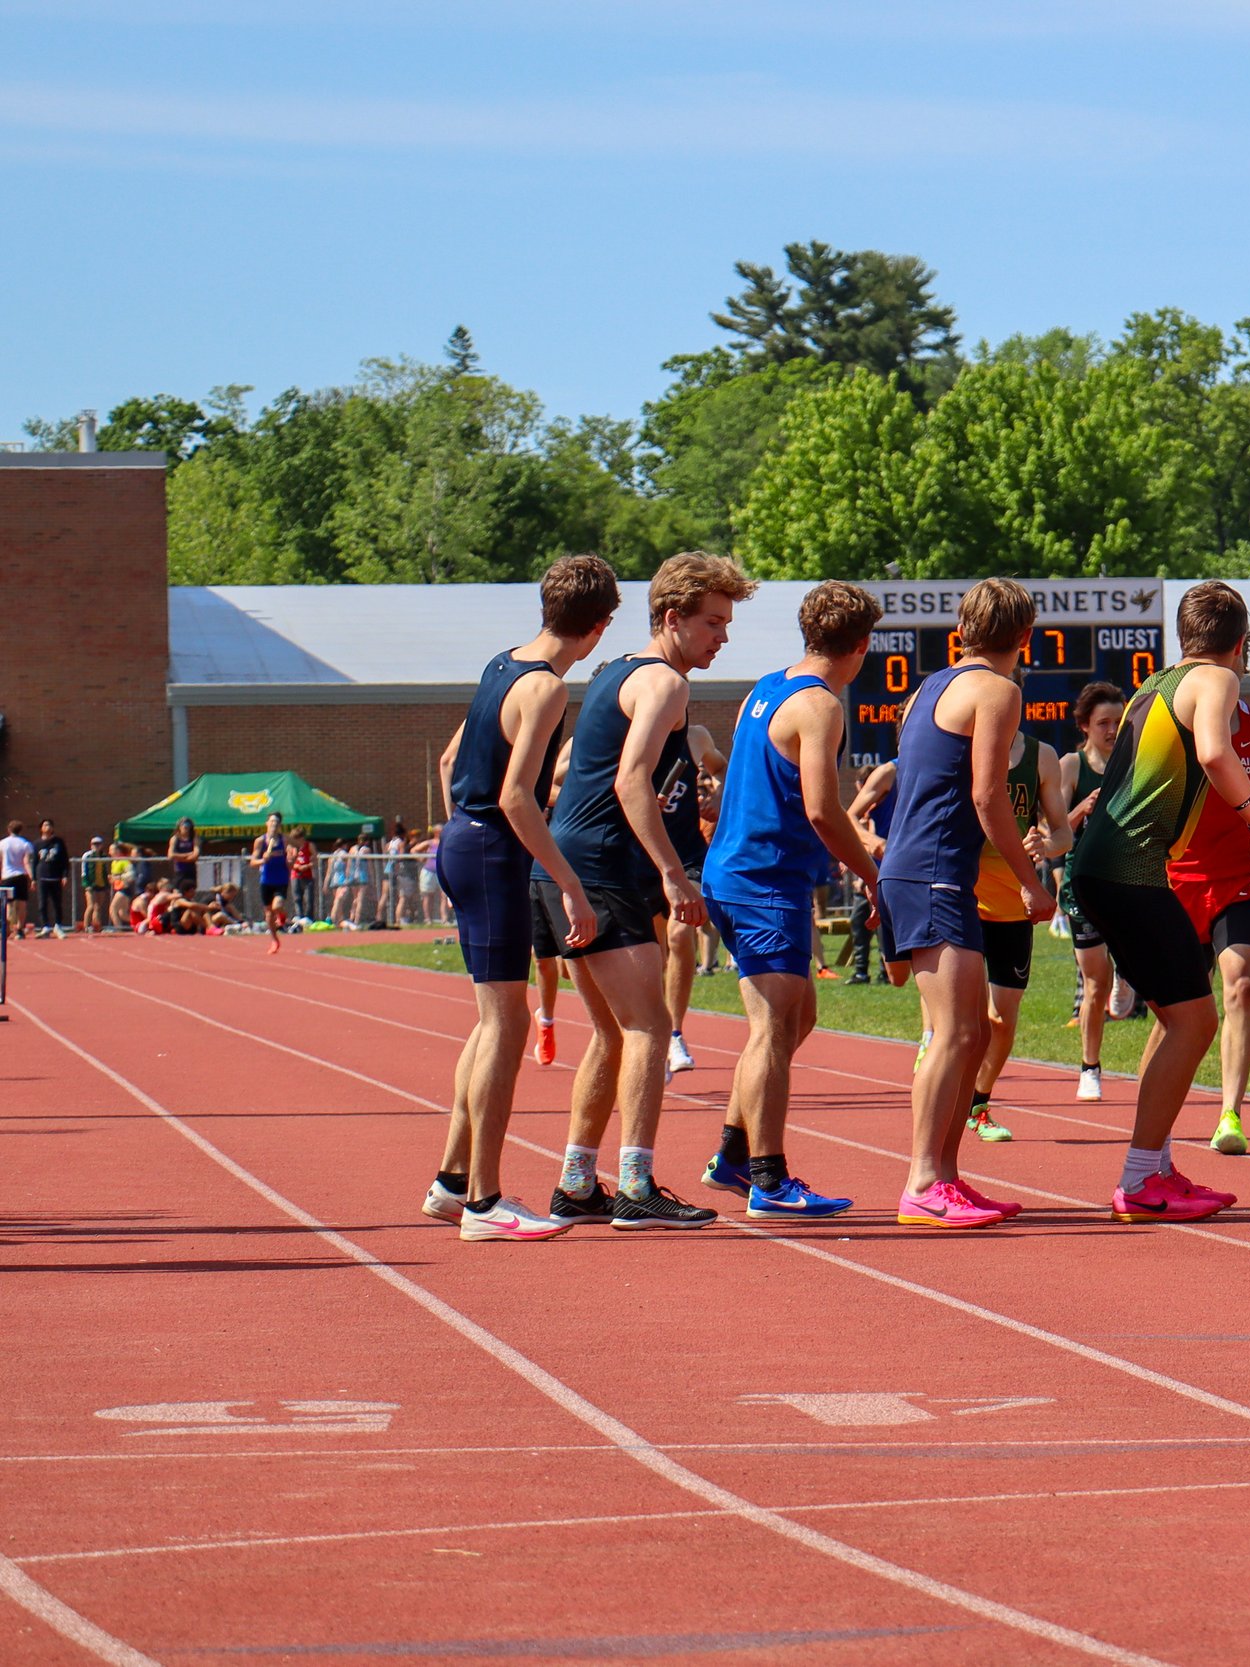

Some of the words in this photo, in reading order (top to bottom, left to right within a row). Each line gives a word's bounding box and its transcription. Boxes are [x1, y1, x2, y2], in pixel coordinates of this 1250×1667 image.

[883, 592, 965, 613] ESSE
[1097, 628, 1159, 650] GUEST
[886, 655, 908, 692] 0
[1025, 701, 1069, 721] HEAT
